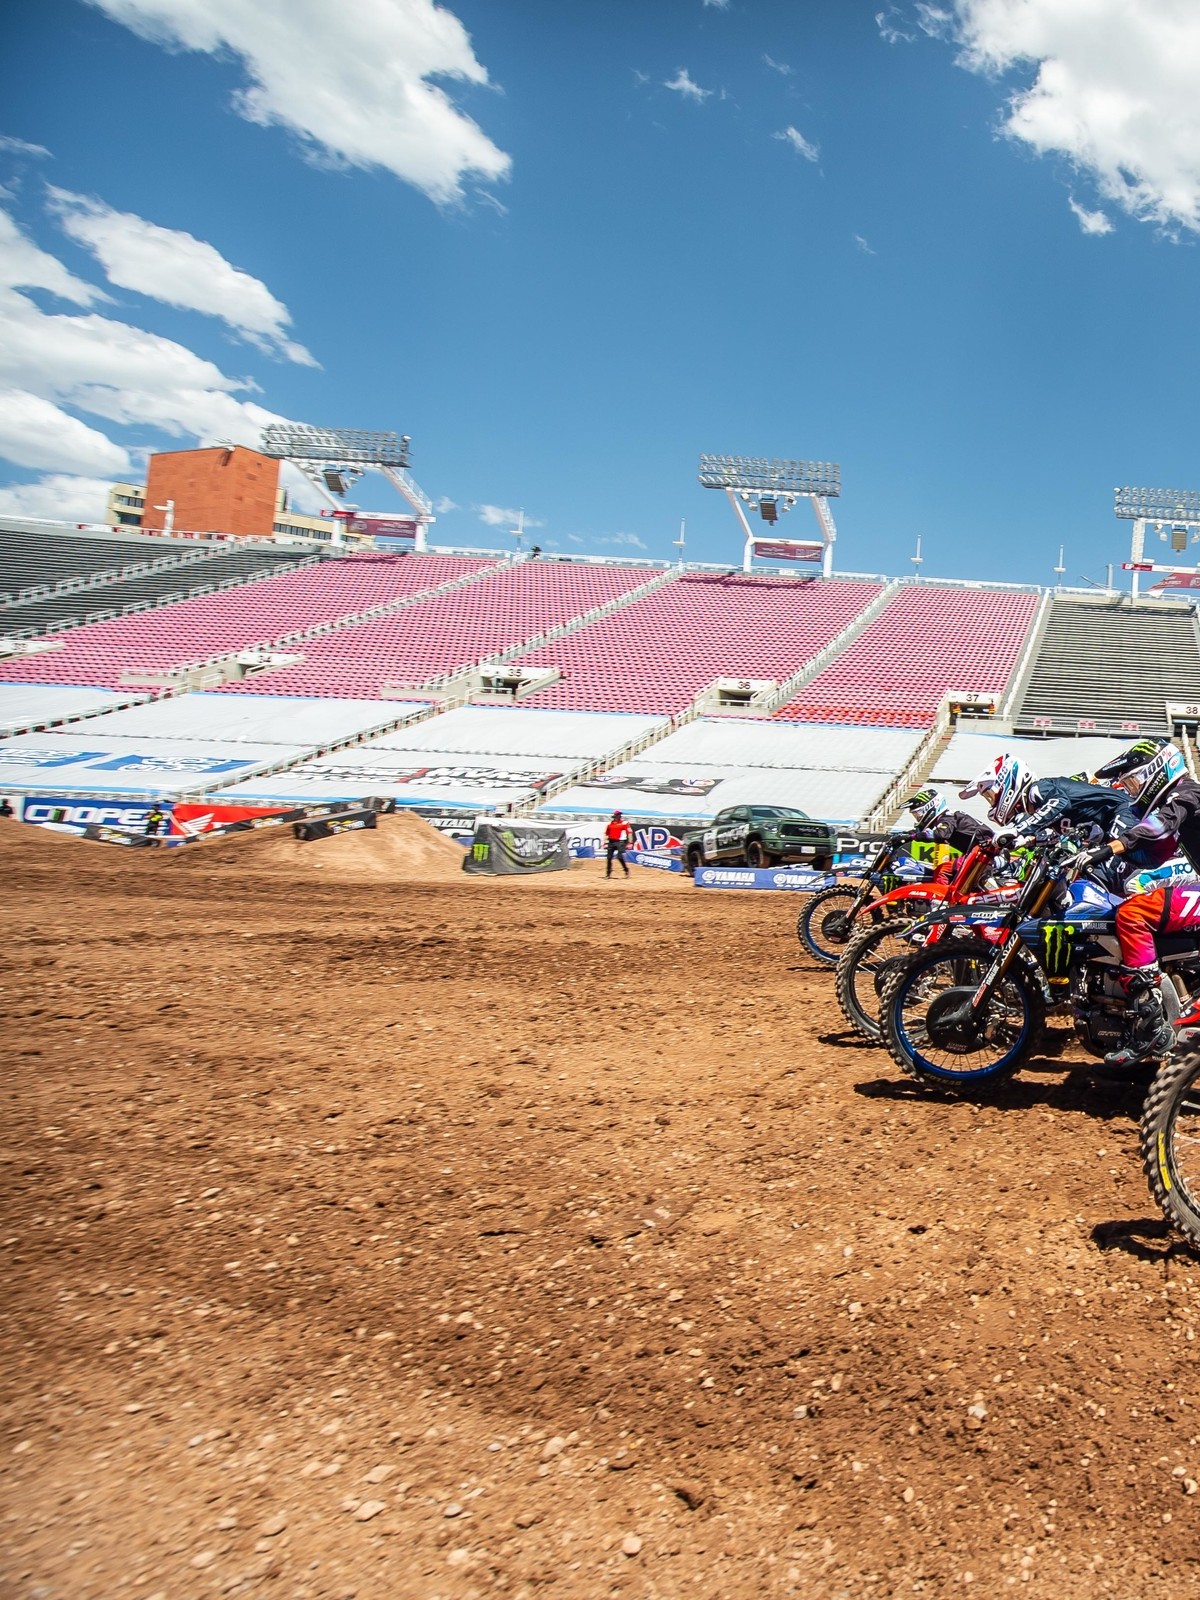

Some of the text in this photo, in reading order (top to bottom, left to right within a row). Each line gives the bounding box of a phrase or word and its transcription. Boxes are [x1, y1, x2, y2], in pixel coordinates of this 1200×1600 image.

[508, 668, 521, 677] 35
[738, 681, 750, 690] 36
[966, 694, 979, 702] 37
[1185, 706, 1199, 715] 38
[998, 789, 1014, 822] GEICO
[1015, 799, 1060, 832] GEICO
[715, 872, 756, 883] YAMAHA
